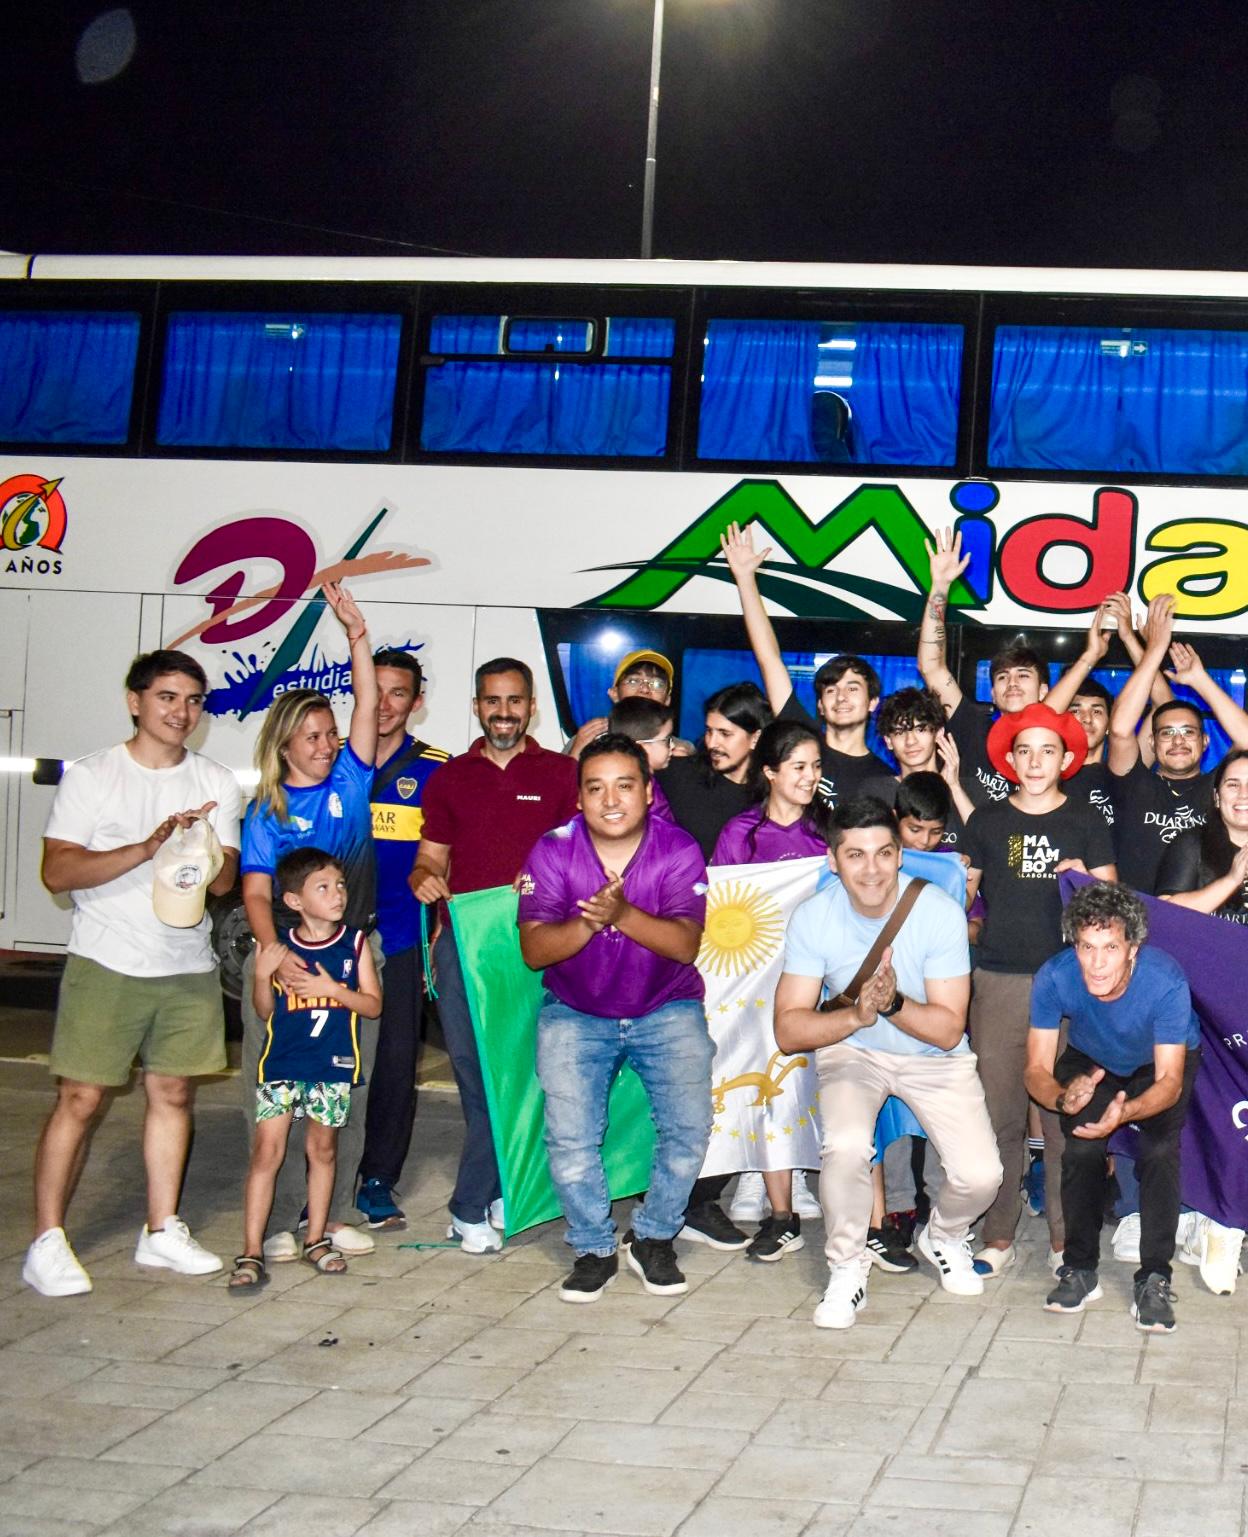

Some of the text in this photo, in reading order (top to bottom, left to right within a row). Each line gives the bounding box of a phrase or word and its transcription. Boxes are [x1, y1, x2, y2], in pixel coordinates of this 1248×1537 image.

[5, 555, 62, 575] AÑOS
[1023, 835, 1050, 847] MA
[1022, 847, 1060, 863] LAM
[1022, 860, 1047, 873] BO
[309, 1009, 330, 1038] 7
